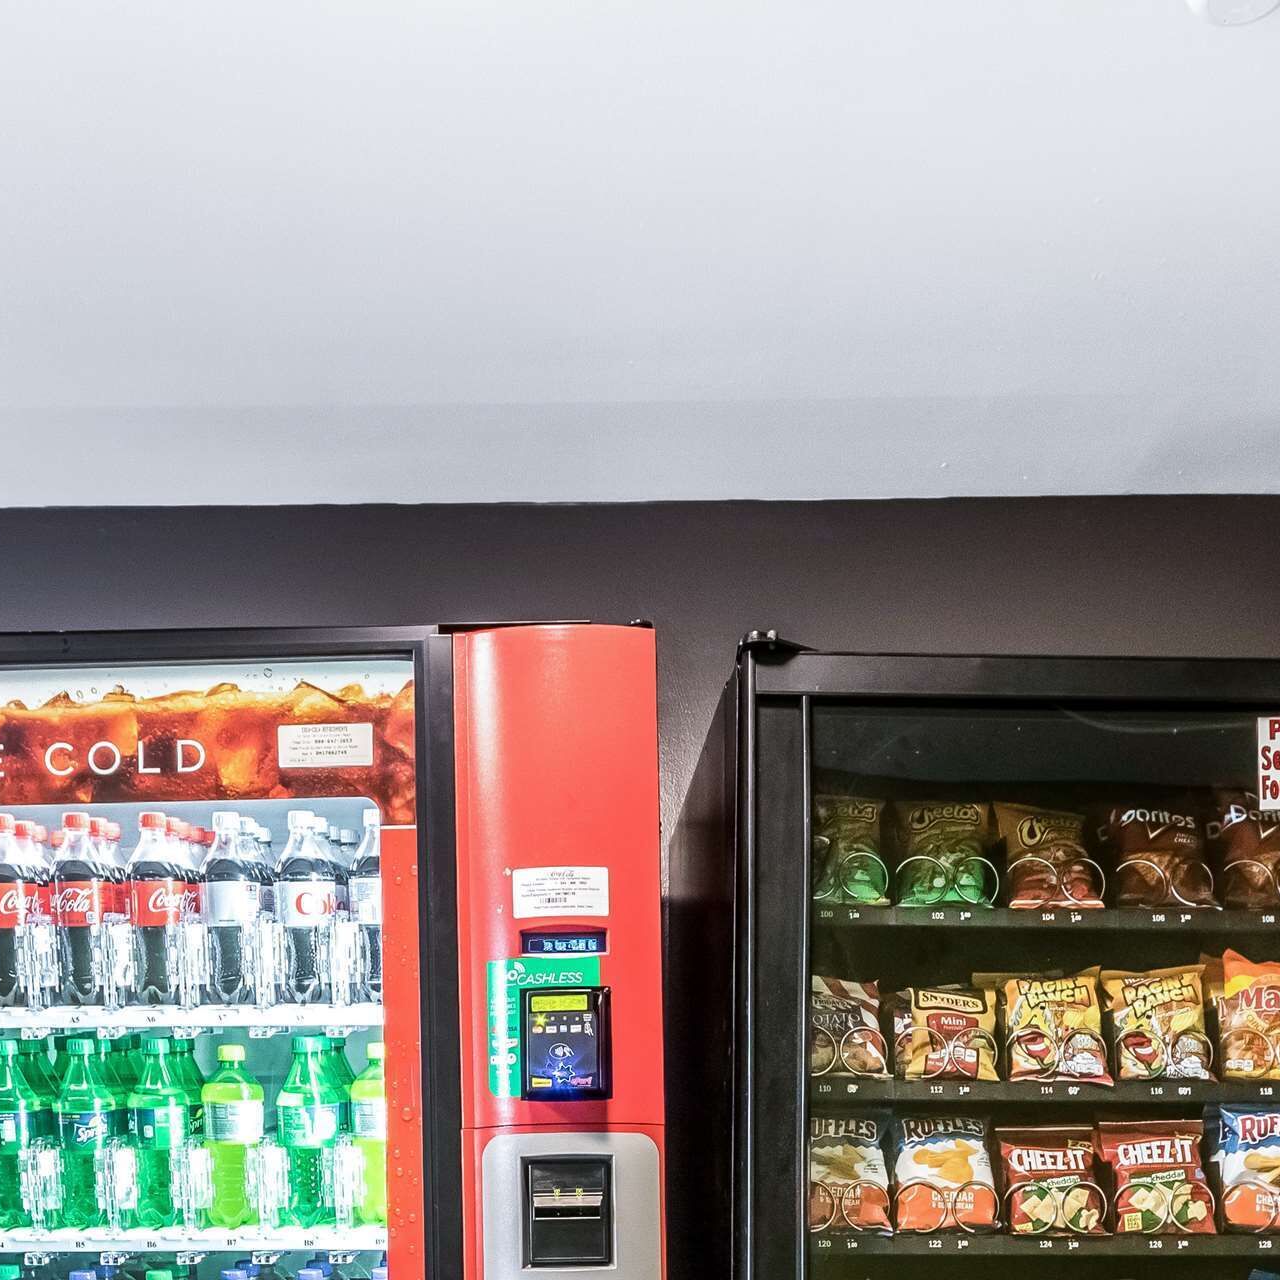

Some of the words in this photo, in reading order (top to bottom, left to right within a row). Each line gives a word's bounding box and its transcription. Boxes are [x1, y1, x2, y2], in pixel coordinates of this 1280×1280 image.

[44, 739, 206, 775] COLD
[909, 803, 981, 833] Cheetos
[1121, 808, 1196, 829] Doritos
[820, 910, 833, 918] 100
[1152, 914, 1165, 922] 106
[517, 972, 583, 985] CASHLESS
[1122, 979, 1184, 1006] RAGIN'
[922, 993, 979, 1009] SNYDER'S
[1027, 987, 1090, 1010] RANCH
[1134, 985, 1199, 1018] RANCH
[70, 1016, 80, 1024] A5
[146, 1016, 156, 1024] A6
[941, 1016, 967, 1026] Mini
[930, 1086, 943, 1094] 112
[1040, 1086, 1053, 1094] 114
[1150, 1087, 1163, 1095] 116
[904, 1118, 984, 1143] RUFFLES
[1119, 1139, 1194, 1165] CHEEZ-IT
[1011, 1148, 1085, 1172] CHEEZ-IT
[1151, 1170, 1185, 1184] cheddar
[818, 1240, 832, 1248] 120
[928, 1240, 942, 1248] 122
[1040, 1240, 1052, 1248] 124
[1149, 1240, 1162, 1248] 126
